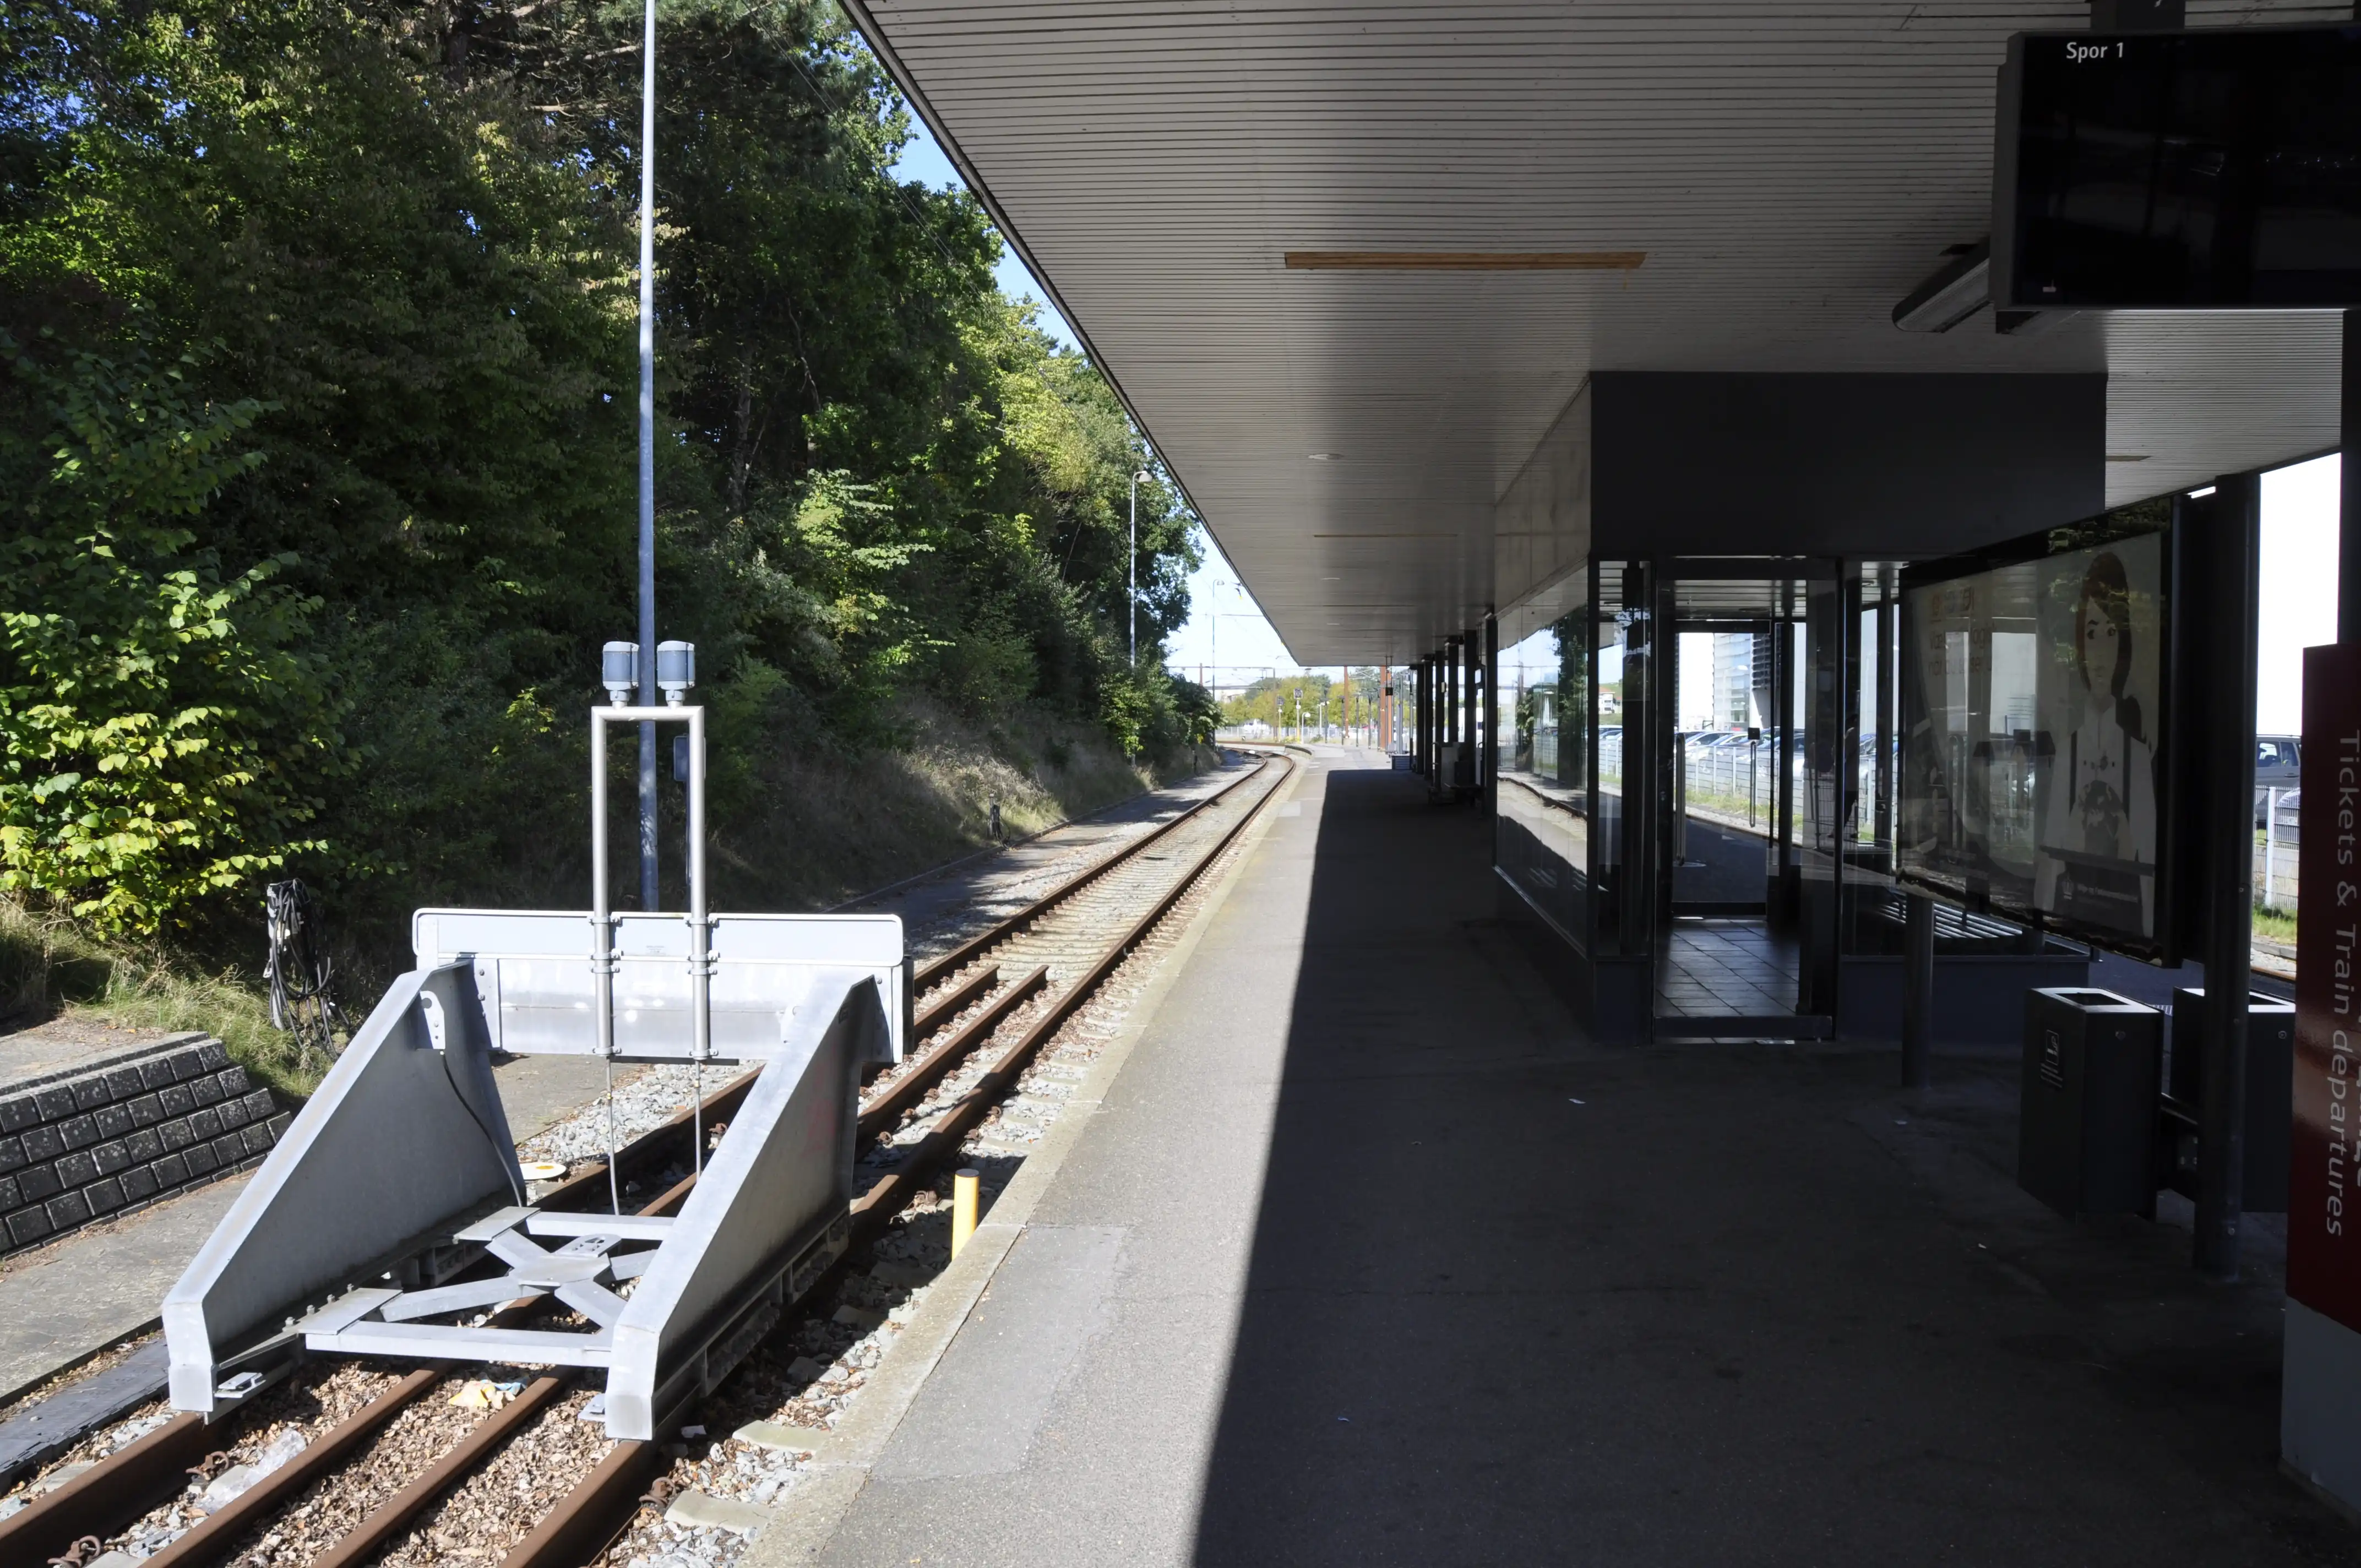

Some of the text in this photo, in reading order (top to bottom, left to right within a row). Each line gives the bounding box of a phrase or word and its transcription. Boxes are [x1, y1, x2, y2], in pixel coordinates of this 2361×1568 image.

[2066, 41, 2124, 63] Spor 1
[2326, 728, 2360, 1237] Tickets & Train departures
